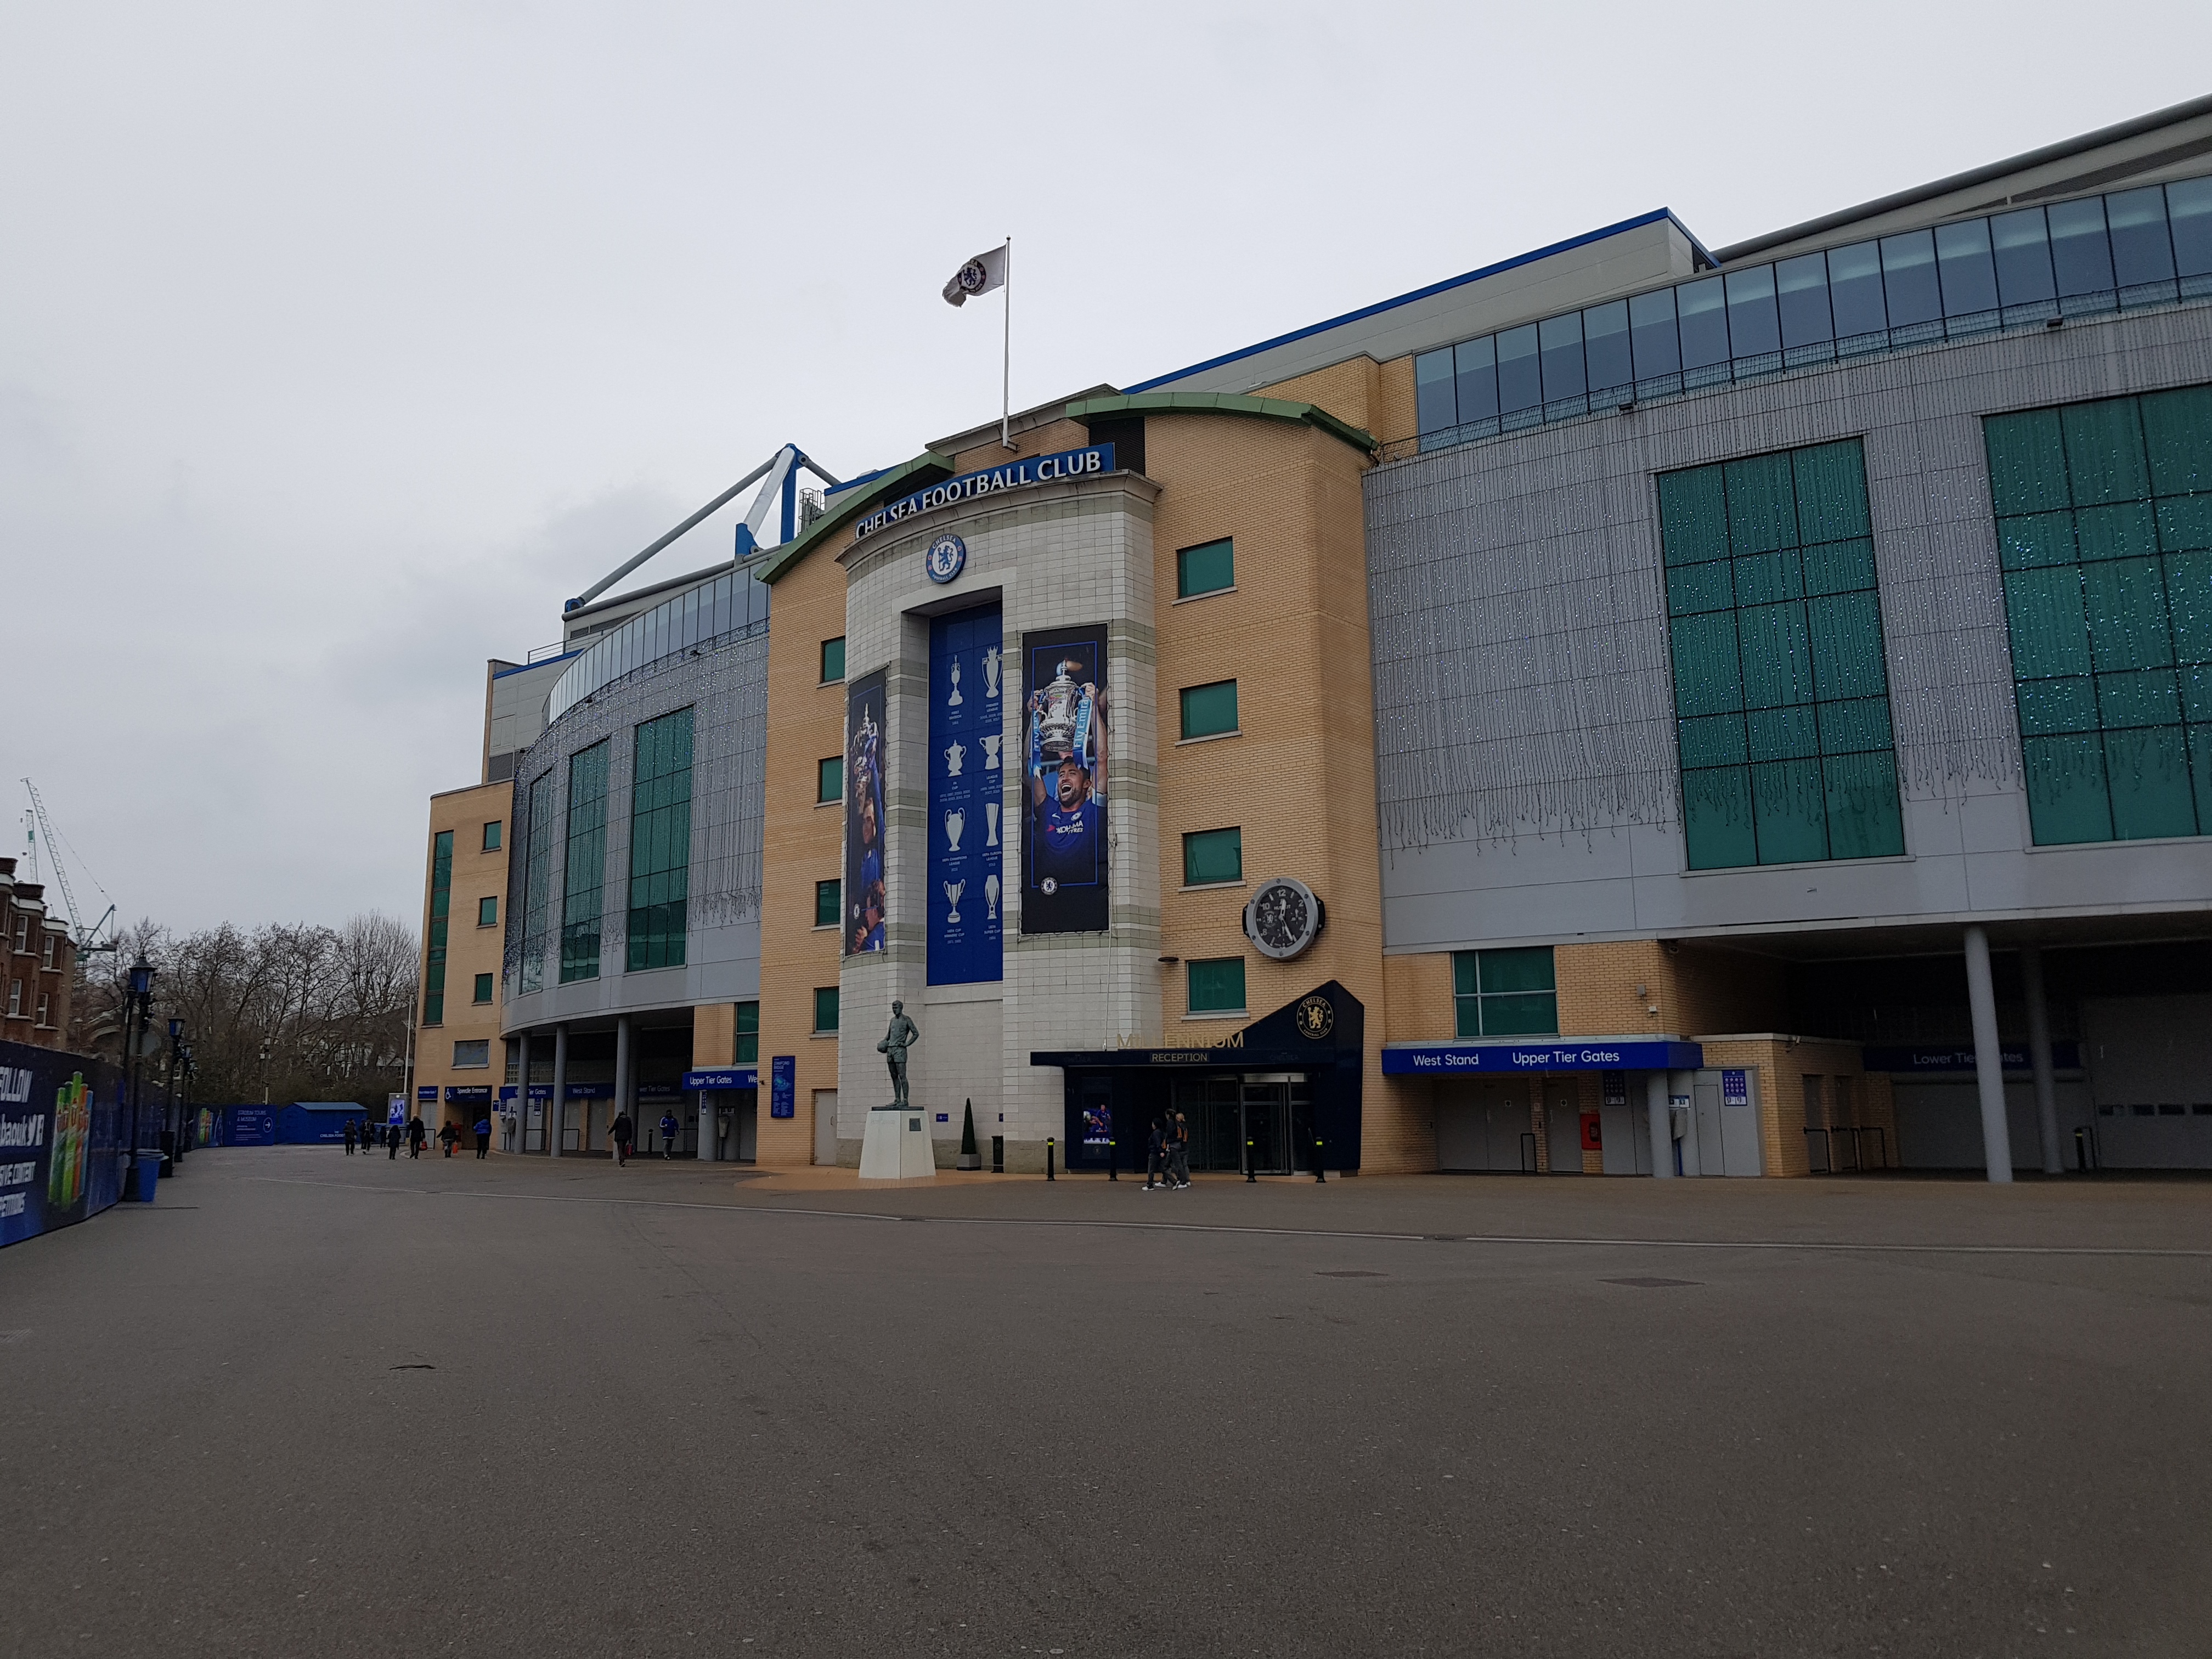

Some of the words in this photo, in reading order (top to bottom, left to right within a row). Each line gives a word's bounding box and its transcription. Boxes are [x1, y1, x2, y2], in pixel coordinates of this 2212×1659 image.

[856, 497, 917, 539] CHELSEA
[922, 465, 1031, 510] FOOTBALL
[1037, 451, 1101, 481] CLUB
[933, 535, 956, 549] CHELSEA
[1277, 889, 1286, 897] 12
[1298, 899, 1304, 907] 2
[1302, 998, 1326, 1008] CHELSEA
[1117, 1031, 1244, 1048] MILLENNIUM
[1152, 1053, 1207, 1062] RECEPTION
[1413, 1054, 1442, 1066] West
[1445, 1053, 1480, 1065] Stand
[1513, 1052, 1550, 1066] Upper
[1553, 1051, 1577, 1063] Tier
[1581, 1050, 1620, 1062] Gates
[1913, 1053, 1953, 1064] Lower
[1954, 1052, 1975, 1063] Tie
[2000, 1052, 2023, 1063] tes
[690, 1076, 705, 1087] Upper
[706, 1076, 715, 1084] Tier
[716, 1076, 732, 1084] Gates
[0, 1113, 27, 1147] baouk
